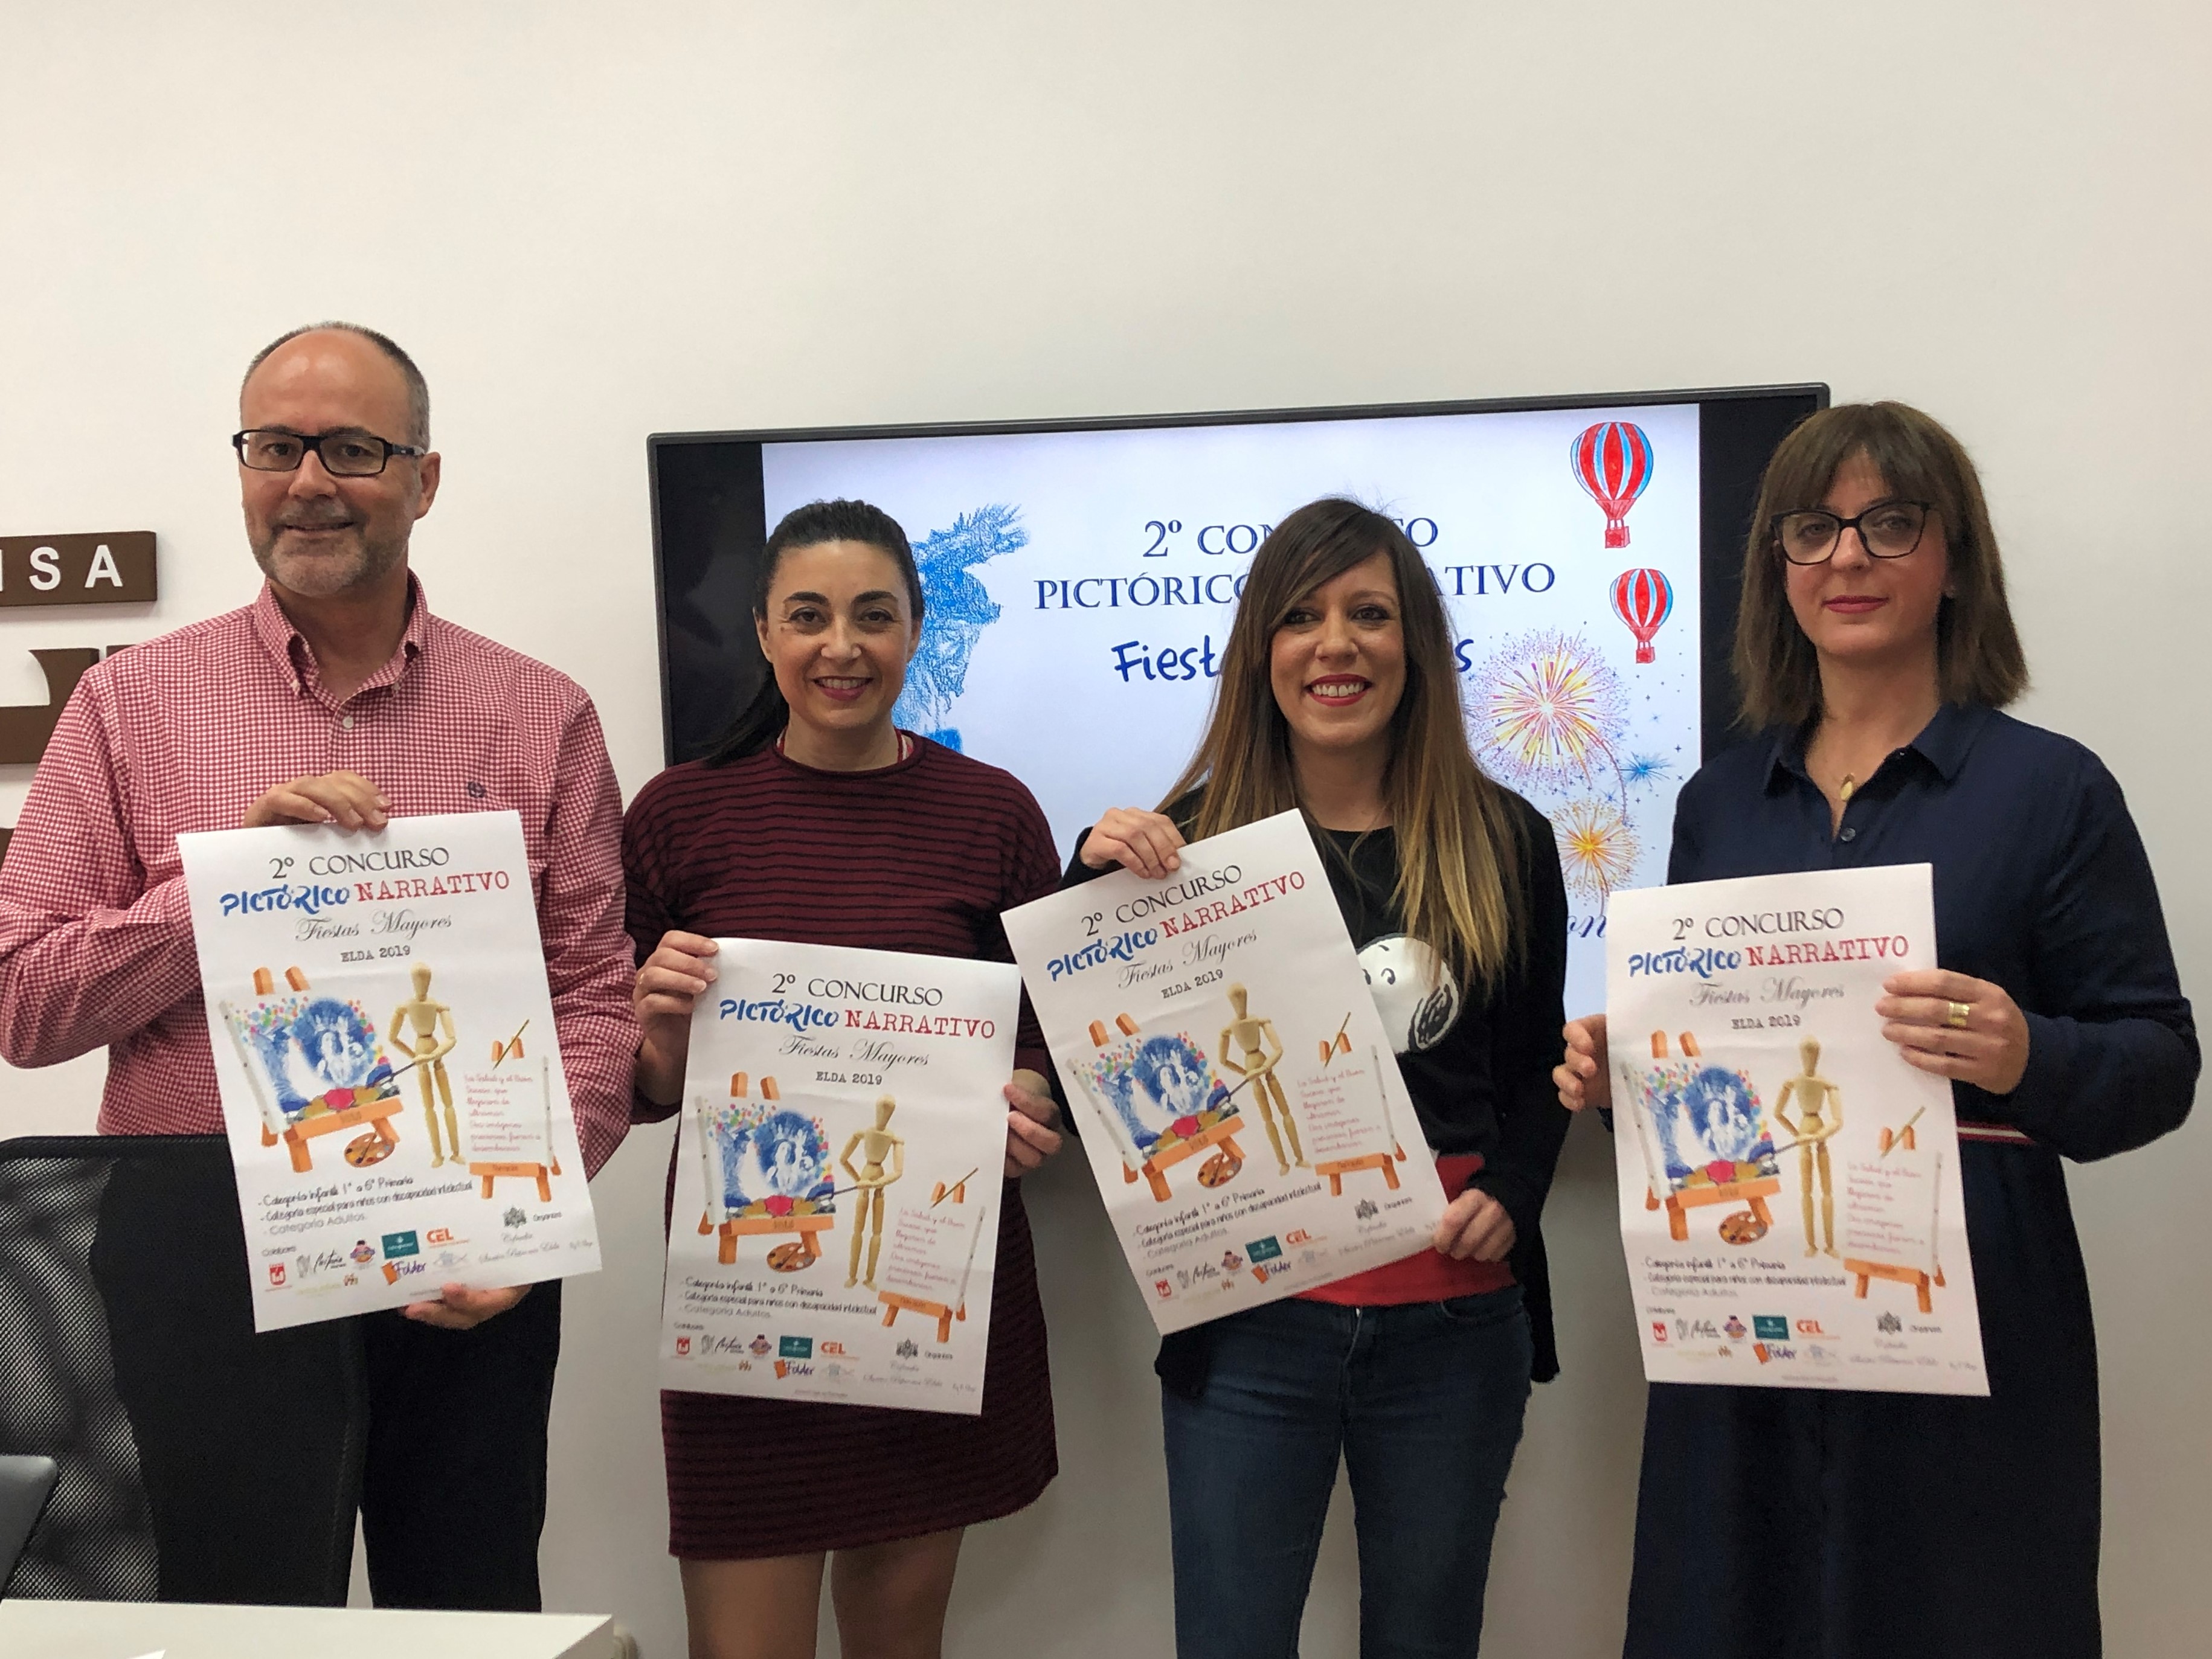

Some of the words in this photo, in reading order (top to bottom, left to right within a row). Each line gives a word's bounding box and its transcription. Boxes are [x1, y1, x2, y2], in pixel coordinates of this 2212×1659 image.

[1143, 519, 1182, 557] 2º
[269, 856, 294, 879] 2º
[309, 847, 449, 875] CONCURSO
[220, 884, 349, 915] PICTÓRICO
[354, 871, 509, 901] NARRATIVO
[1081, 911, 1102, 936] 2º
[1115, 865, 1241, 923] CONCURSO
[295, 918, 359, 941] Fiestas
[370, 909, 451, 940] Mayores
[1047, 928, 1157, 981] PICTÓRICO
[1159, 871, 1304, 937] NARRATIVO
[1705, 908, 1844, 937] CONCURSO
[340, 949, 375, 962] ELDA
[379, 945, 410, 958] 2019
[1117, 962, 1173, 987] Fiestas
[1183, 934, 1256, 964] Mayores
[1746, 935, 1908, 966] NARRATIVO
[771, 973, 796, 993] 2º
[808, 978, 942, 1006] CONCURSO
[1160, 981, 1192, 998] ELDA
[1194, 969, 1223, 986] 2019
[1689, 983, 1749, 1005] Fiestas
[1760, 976, 1844, 1008] Mayores
[719, 999, 838, 1032] PICTÓRICO
[845, 1009, 994, 1038] NARRATIVO
[1731, 1018, 1764, 1030] ELDA
[1768, 1014, 1800, 1027] 2019
[779, 1035, 838, 1058] Fiestas
[849, 1041, 928, 1071] Mayores
[815, 1071, 846, 1083] ELDA
[852, 1073, 882, 1085] 2019
[378, 1176, 413, 1188] Primaria
[335, 1201, 355, 1211] para
[426, 1228, 454, 1243] CEL
[1285, 1228, 1311, 1245] CEL
[820, 1341, 845, 1355] CEL
